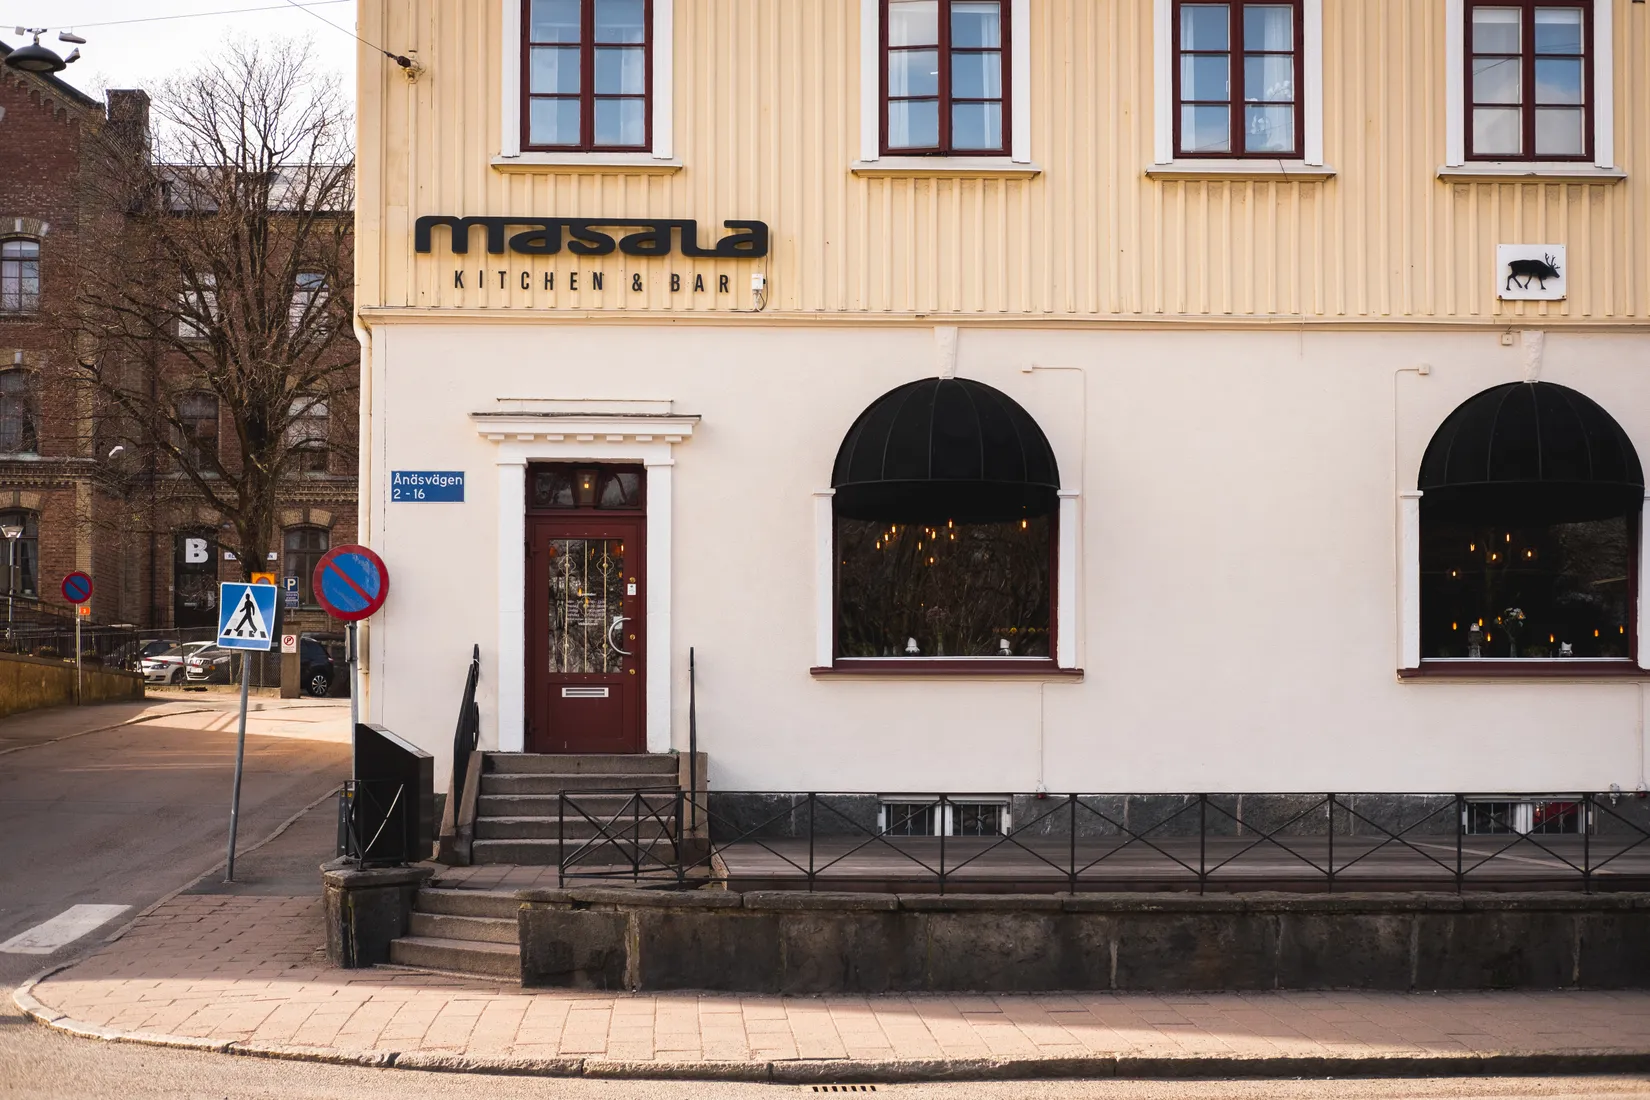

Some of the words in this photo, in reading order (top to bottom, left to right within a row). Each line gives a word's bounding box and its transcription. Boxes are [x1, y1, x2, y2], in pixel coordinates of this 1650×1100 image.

[454, 270, 605, 291] KITCHEN
[632, 272, 643, 292] &
[671, 273, 730, 293] BAR
[393, 472, 463, 488] Ånäsvägen
[185, 538, 209, 563] B
[287, 578, 296, 591] P
